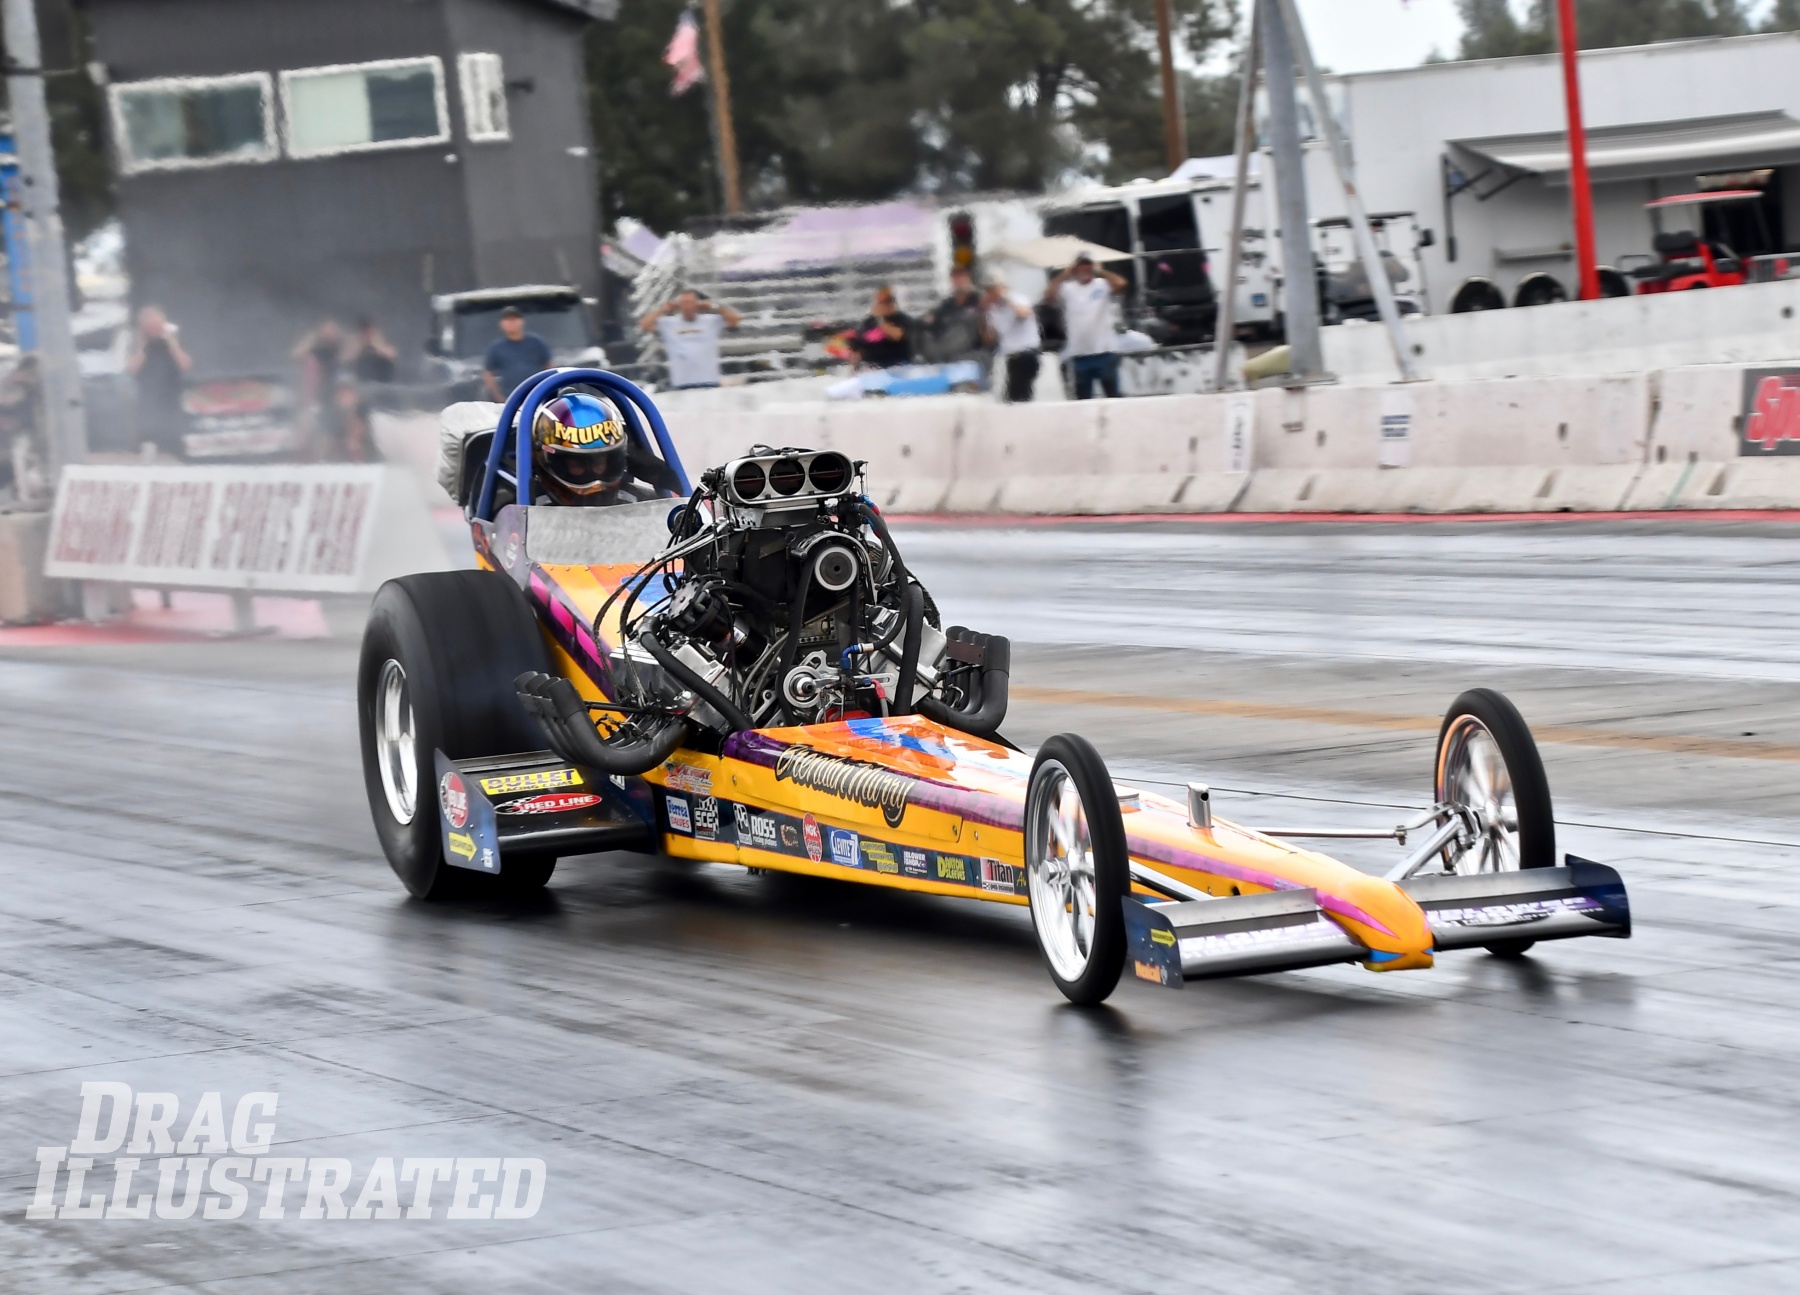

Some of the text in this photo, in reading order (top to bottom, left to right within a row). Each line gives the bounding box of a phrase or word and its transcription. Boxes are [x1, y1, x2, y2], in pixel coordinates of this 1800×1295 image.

[555, 420, 622, 444] MURRY
[487, 769, 575, 790] BULLET
[498, 780, 574, 793] RACING CAMS
[524, 795, 594, 810] RED LINE
[695, 810, 713, 828] SCE
[751, 815, 776, 839] ROSS
[805, 824, 818, 837] NGK
[987, 860, 1013, 883] Titan
